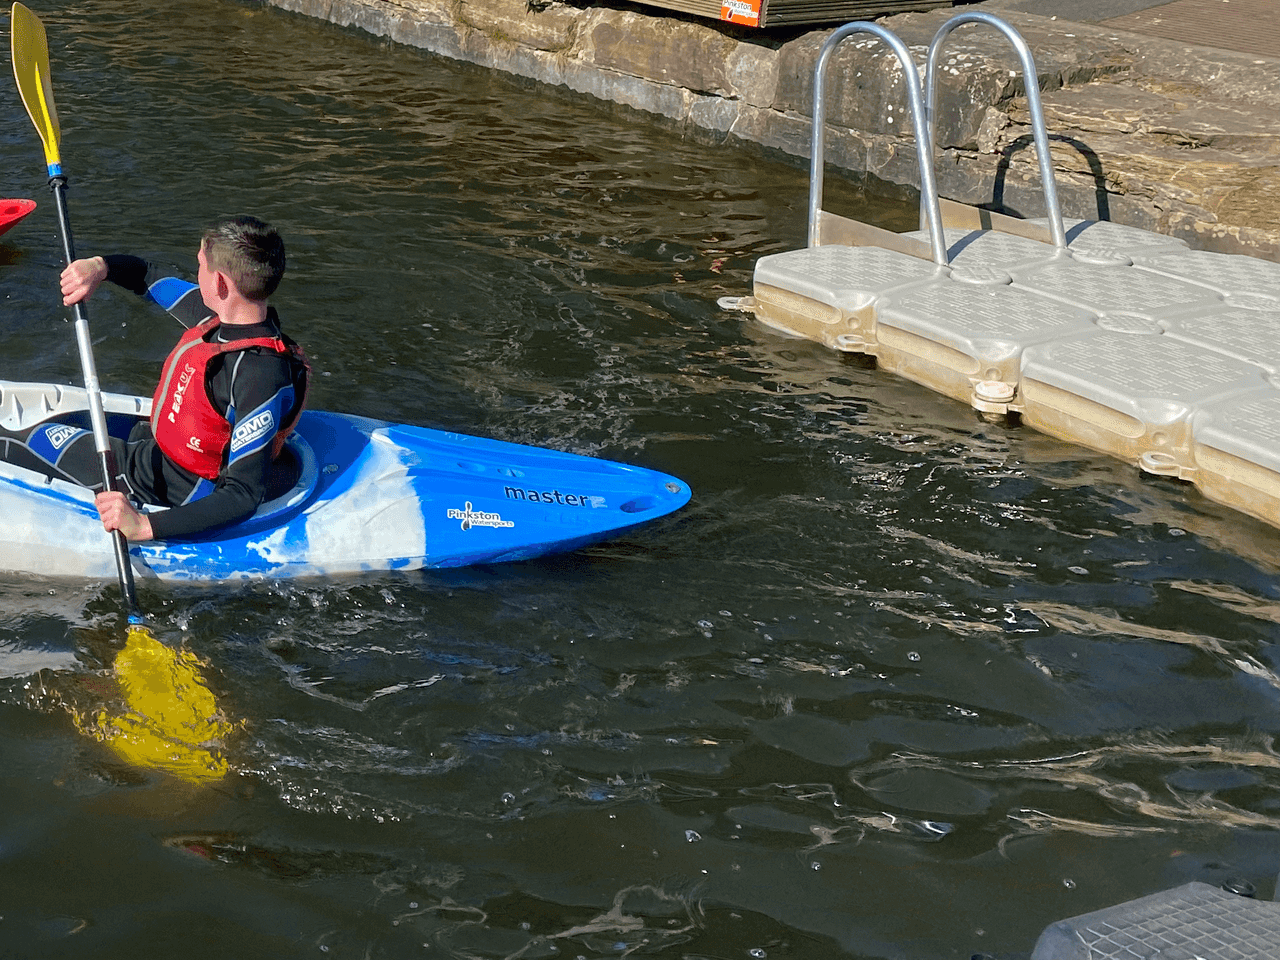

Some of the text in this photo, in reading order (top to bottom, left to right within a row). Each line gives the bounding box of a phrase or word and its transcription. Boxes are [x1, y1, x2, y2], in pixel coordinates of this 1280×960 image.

[504, 486, 589, 507] master
[448, 509, 499, 520] Pinkston
[470, 519, 513, 528] Watersports
